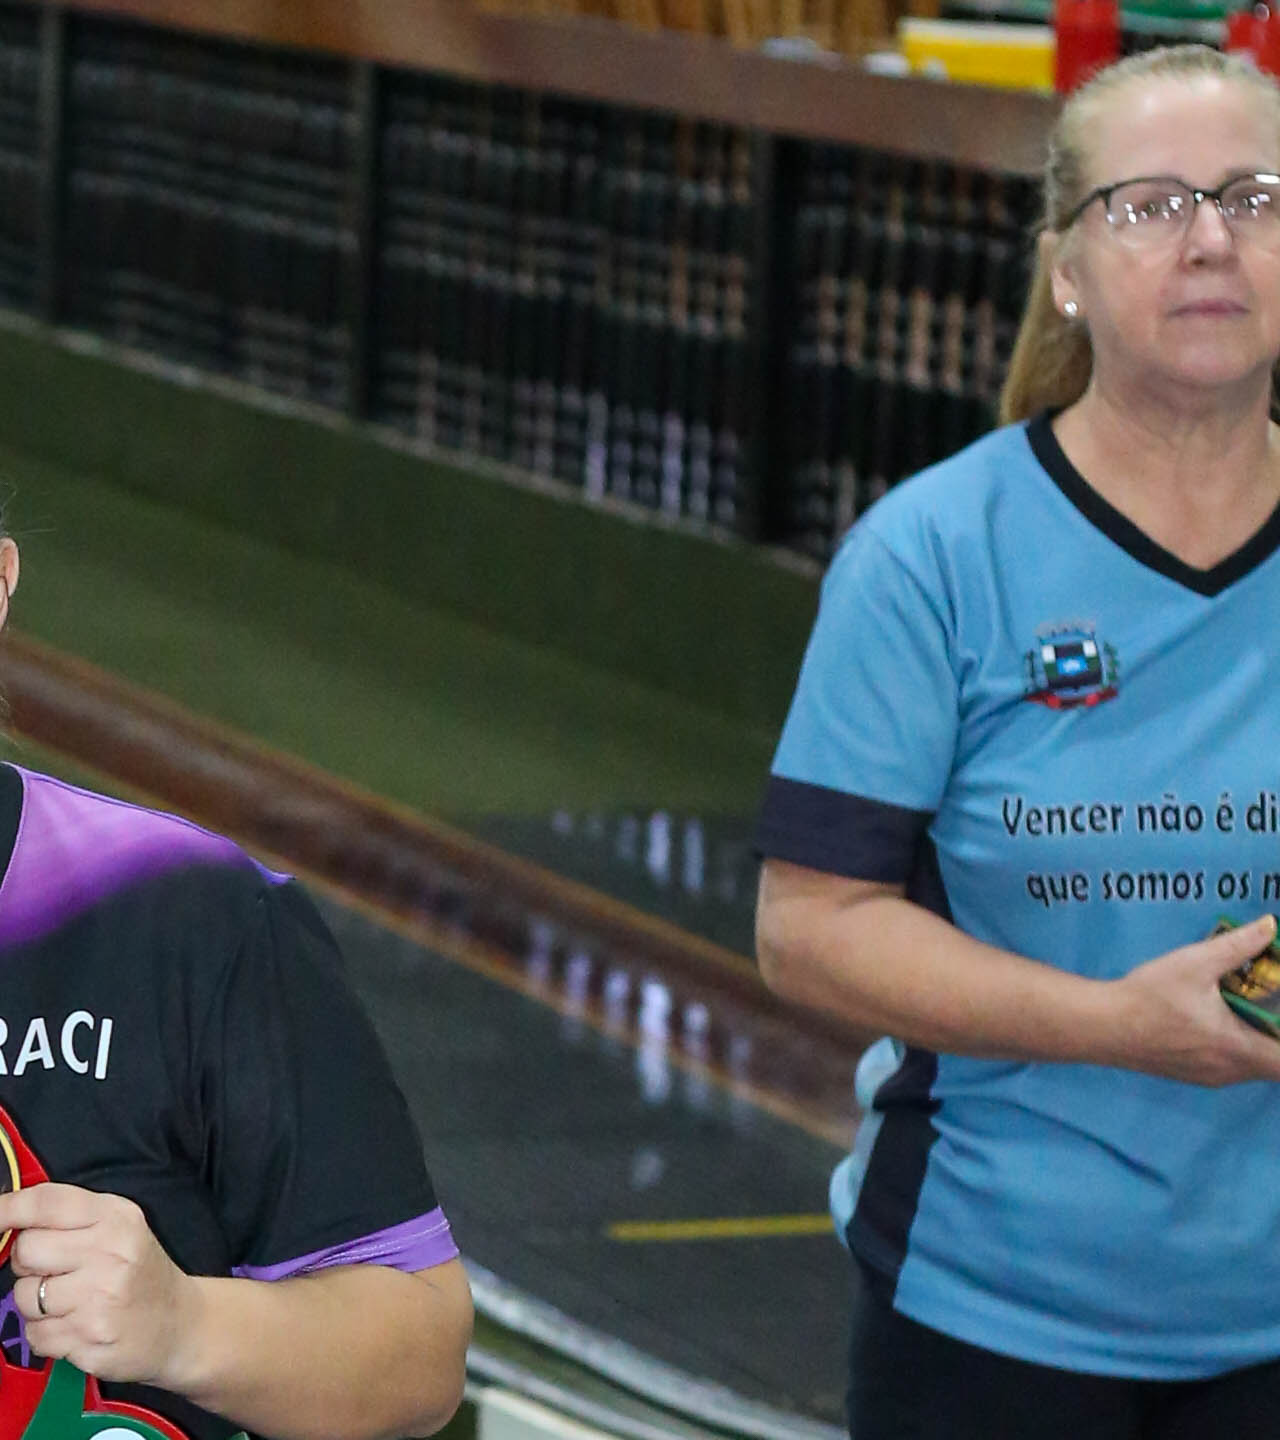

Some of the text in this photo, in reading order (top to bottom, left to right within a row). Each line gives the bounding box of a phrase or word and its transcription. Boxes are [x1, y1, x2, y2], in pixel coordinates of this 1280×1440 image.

[1002, 796, 1124, 836] Vencer
[1137, 793, 1204, 832] não
[1215, 792, 1234, 833] é
[1027, 872, 1090, 907] que
[1102, 871, 1205, 900] somos
[1217, 872, 1250, 900] os
